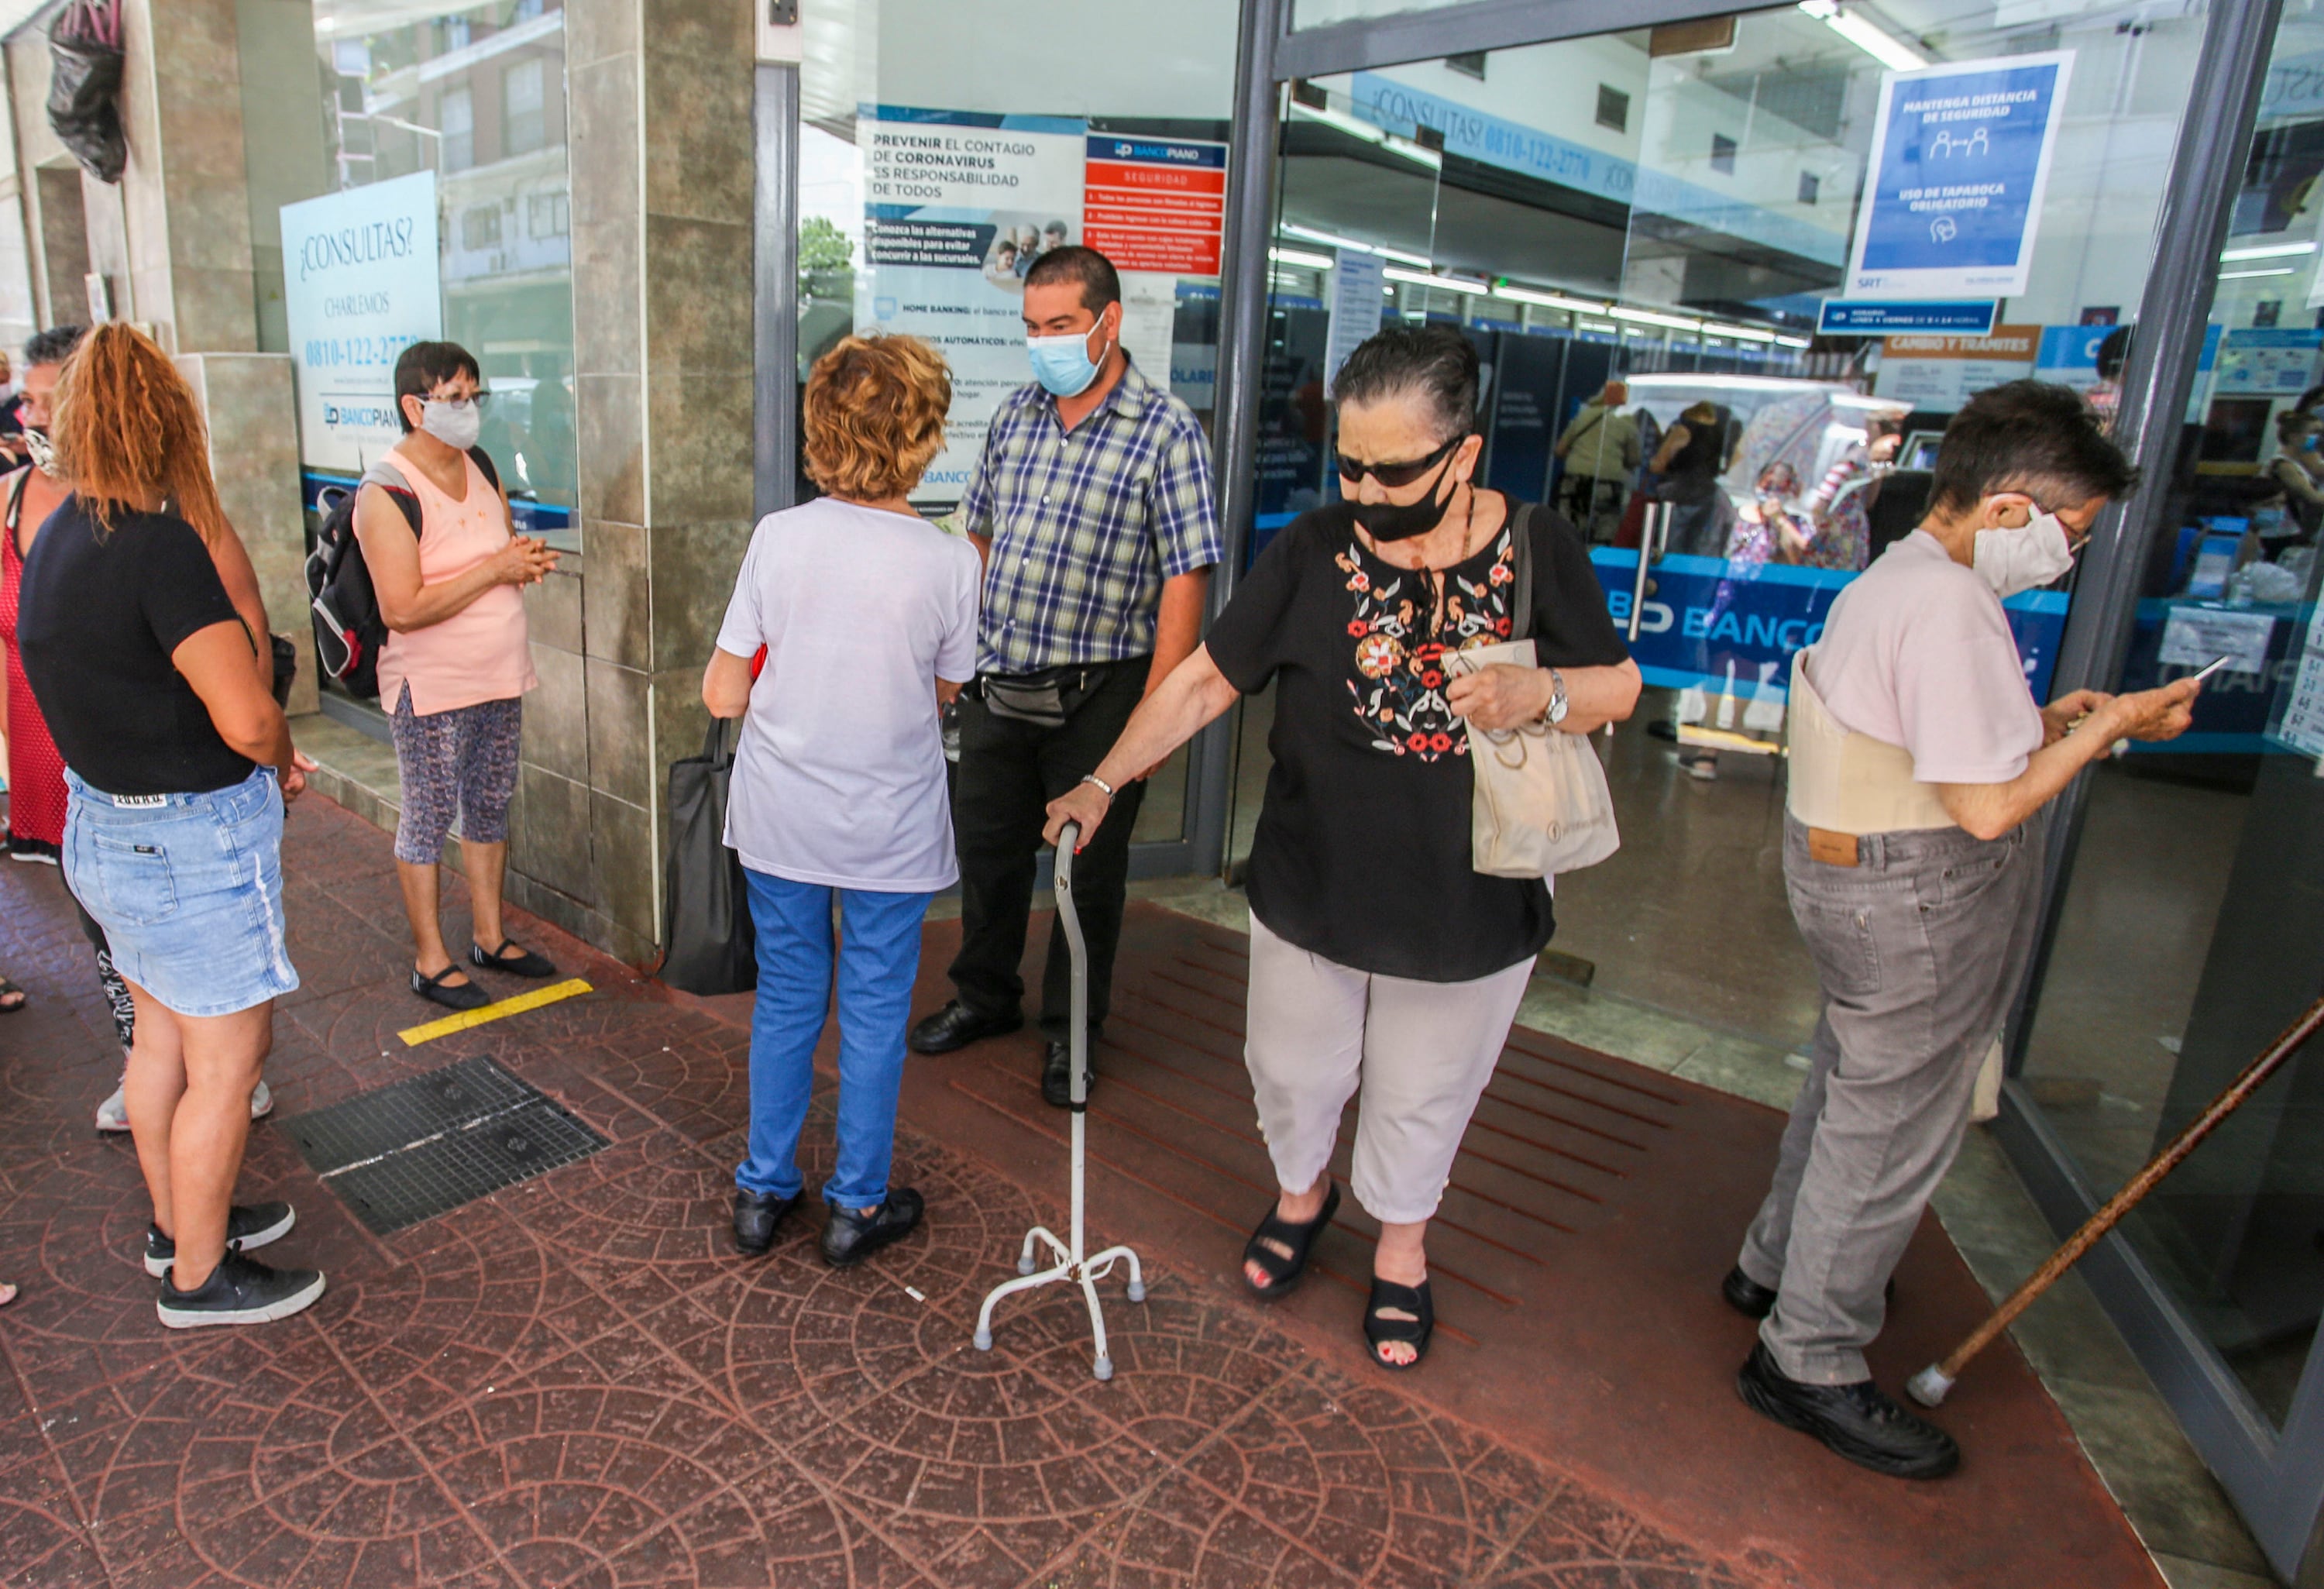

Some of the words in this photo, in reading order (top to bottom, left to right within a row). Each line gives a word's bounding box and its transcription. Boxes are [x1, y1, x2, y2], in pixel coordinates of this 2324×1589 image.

[1903, 96, 1970, 113] MANTENGA
[1972, 89, 2037, 106] DISTANCIA
[1923, 112, 1939, 123] DE
[1941, 105, 2010, 122] SEGURIDAD
[874, 134, 941, 149] PREVENIR
[946, 138, 960, 150] EL
[965, 140, 1035, 155] CONTAGIO
[874, 151, 889, 163] DE
[896, 153, 995, 169] CORONAVIRUS
[874, 167, 889, 178] ES
[894, 168, 1019, 187] RESPONSABILIDAD
[1125, 172, 1188, 186] SEGURIDAD
[873, 183, 889, 194] DE
[896, 184, 942, 198] TODOS
[1923, 187, 1940, 199] DE
[1910, 197, 1989, 212] OBLIGATORIO
[911, 225, 924, 236] las
[925, 225, 977, 239] alternativas
[301, 216, 413, 282] ¿CONSULTAS?
[923, 240, 944, 250] para
[944, 240, 970, 251] evitar
[920, 251, 933, 262] las
[325, 291, 390, 318] CHARLEMOS
[930, 306, 971, 315] BANKING:
[983, 307, 1007, 316] banco
[1891, 337, 1944, 350] CAMBIO
[1947, 339, 1958, 350] Y
[341, 405, 401, 428] BANCOPIAN
